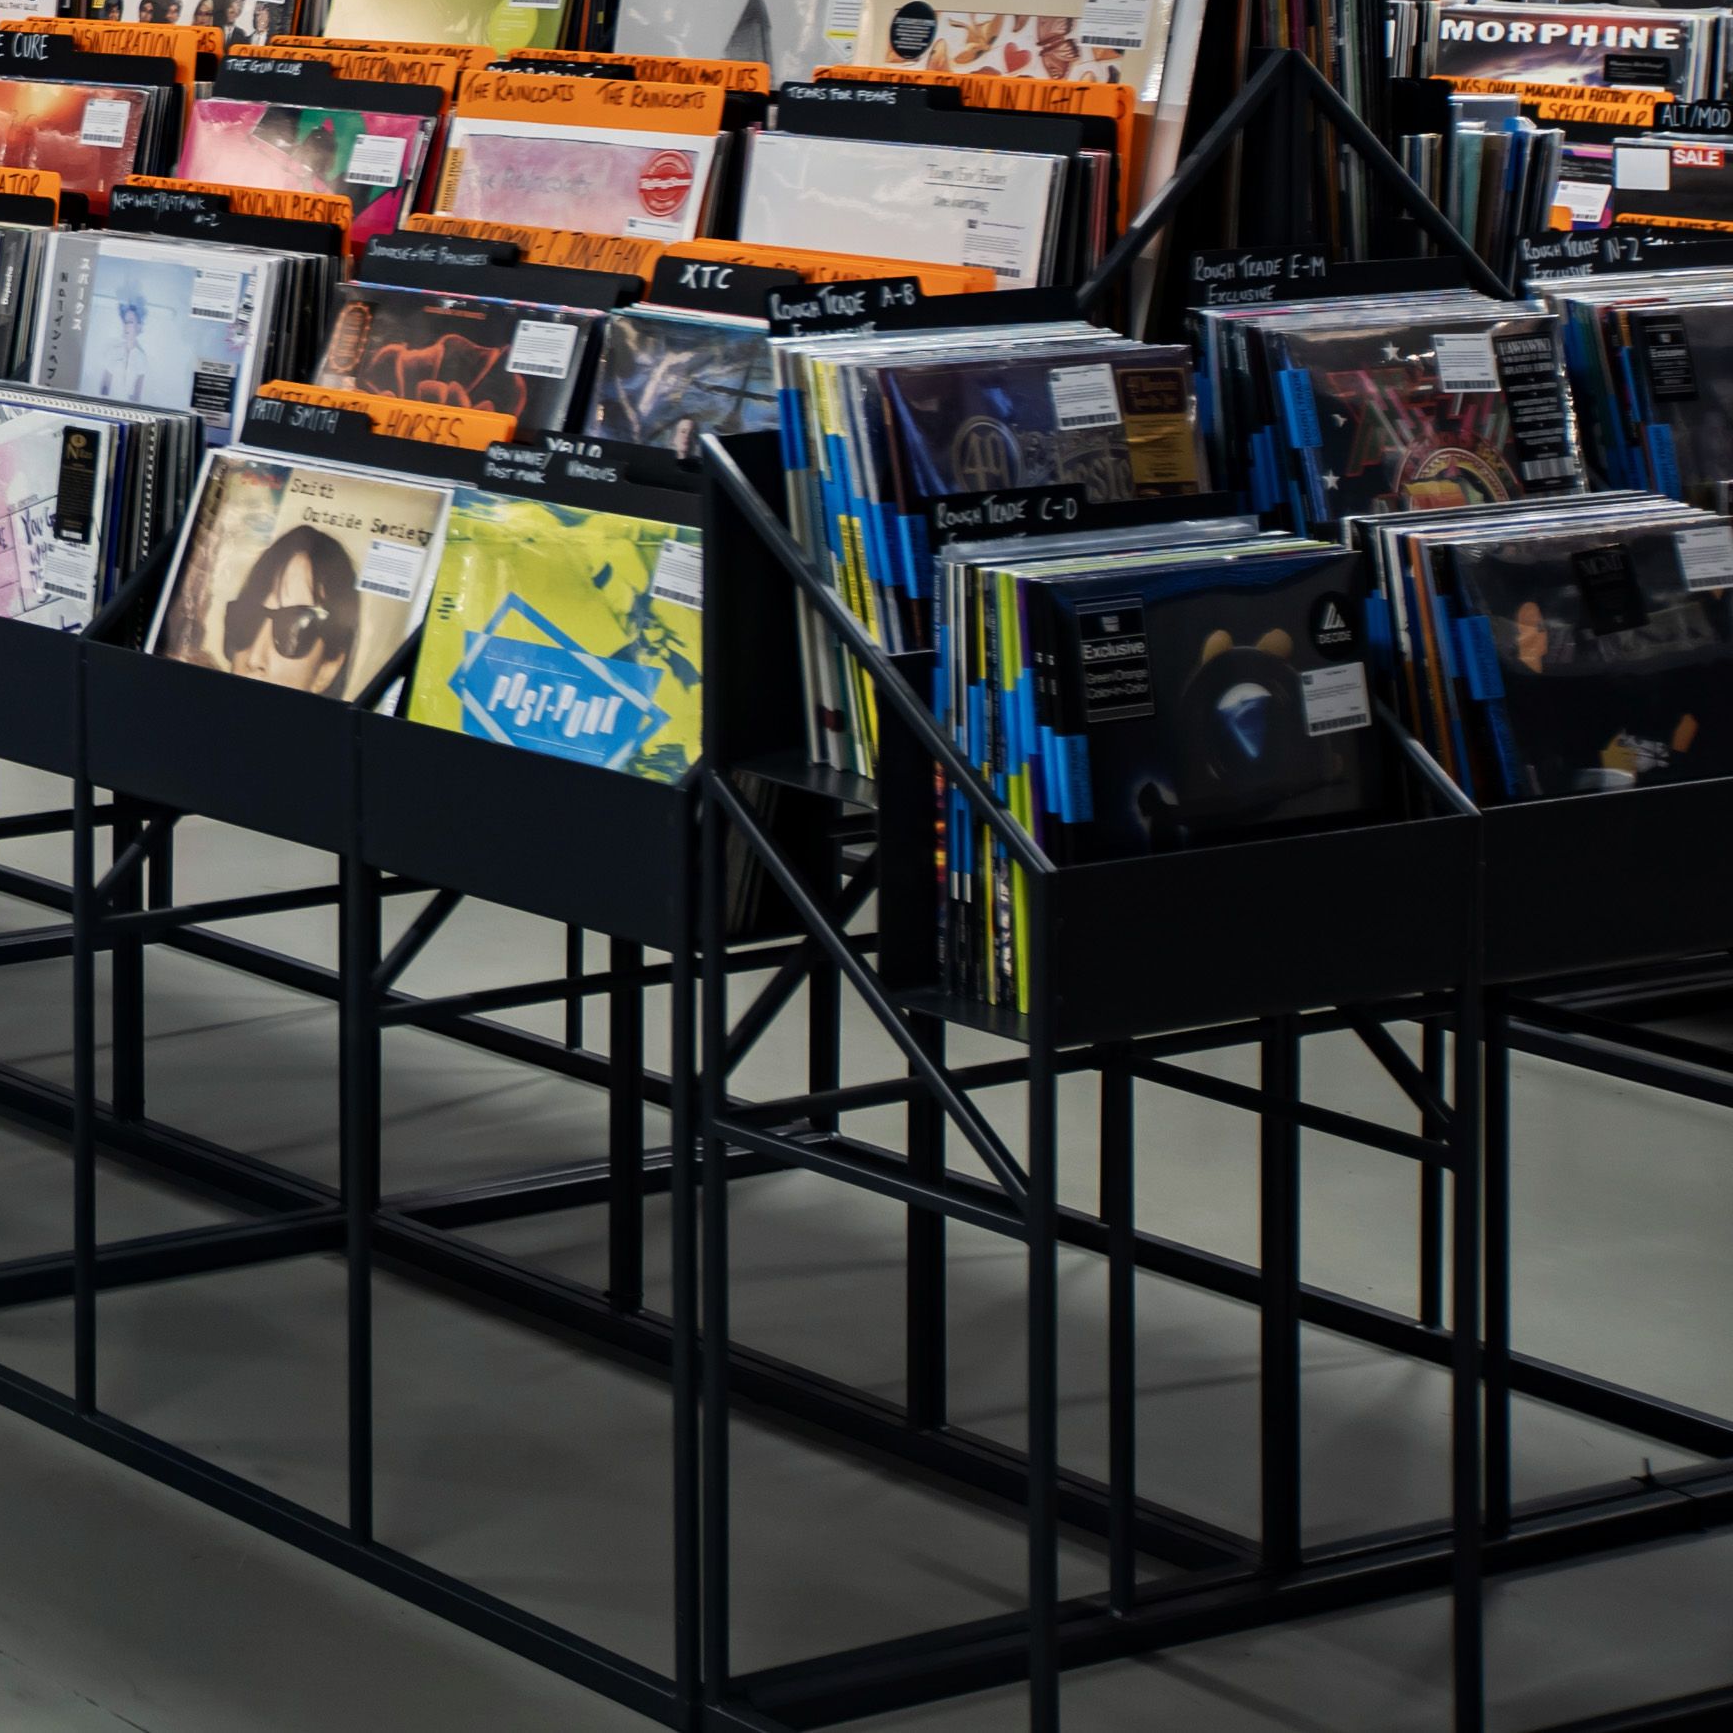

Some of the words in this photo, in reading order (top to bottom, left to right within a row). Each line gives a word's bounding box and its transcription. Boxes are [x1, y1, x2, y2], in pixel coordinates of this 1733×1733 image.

[1440, 18, 1680, 50] MORPHINE
[13, 36, 49, 59] CURE
[463, 75, 486, 100] THE
[494, 76, 574, 103] RAINCOATS
[596, 83, 623, 106] THE
[632, 85, 708, 109] RAINCOATS
[787, 86, 826, 101] TEARS
[832, 88, 853, 101] FOR
[857, 89, 896, 104] FEARS
[1673, 149, 1720, 166] SALE
[679, 264, 734, 289] XTC
[303, 507, 362, 532] Outside
[1082, 642, 1145, 662] Exclusive
[490, 674, 623, 738] POST-PUNK
